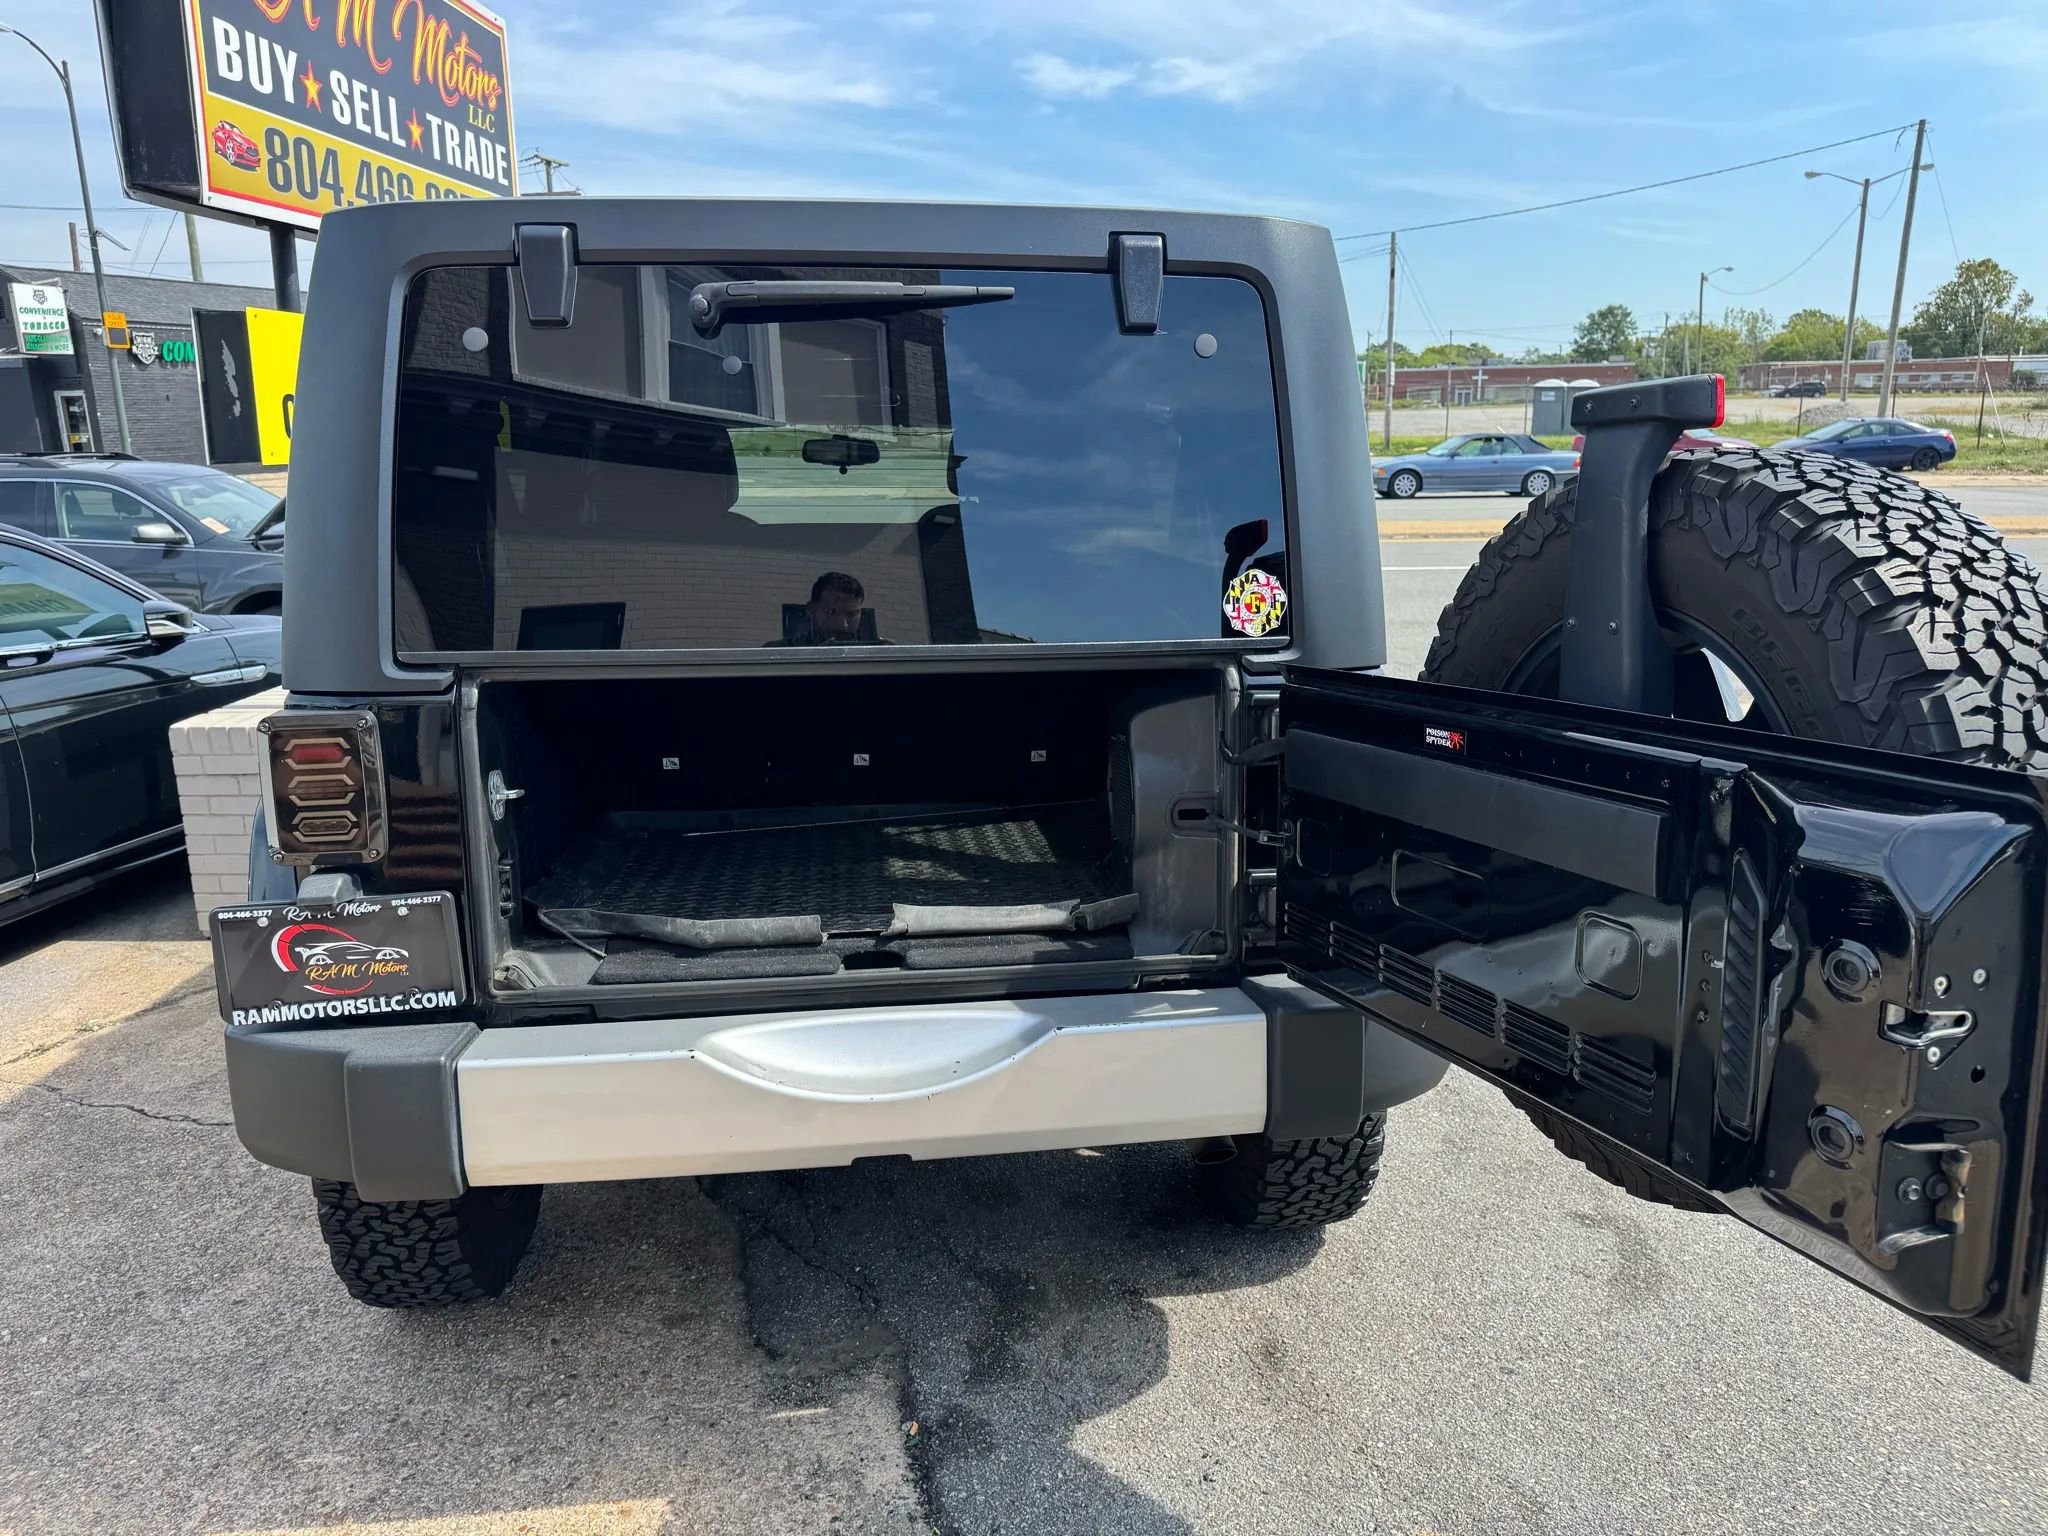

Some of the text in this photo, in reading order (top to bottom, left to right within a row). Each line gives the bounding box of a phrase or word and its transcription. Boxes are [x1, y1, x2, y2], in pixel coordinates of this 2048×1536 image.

[392, 0, 502, 111] Motors
[212, 16, 297, 104] BUY
[329, 70, 406, 147] SELL
[425, 112, 509, 186] TRADE
[468, 104, 495, 133] LLC
[19, 307, 64, 317] CONVENIENCE
[23, 321, 66, 331] TOBACCO
[1426, 727, 1451, 739] POISON
[1425, 735, 1454, 749] SPYDER
[391, 896, 441, 906] 804-466-3377
[217, 909, 272, 920] 804-466-3377
[337, 901, 382, 917] Motors
[305, 961, 409, 981] RAM Motors
[232, 991, 457, 1026] RAMMOTORSLLC.COM
